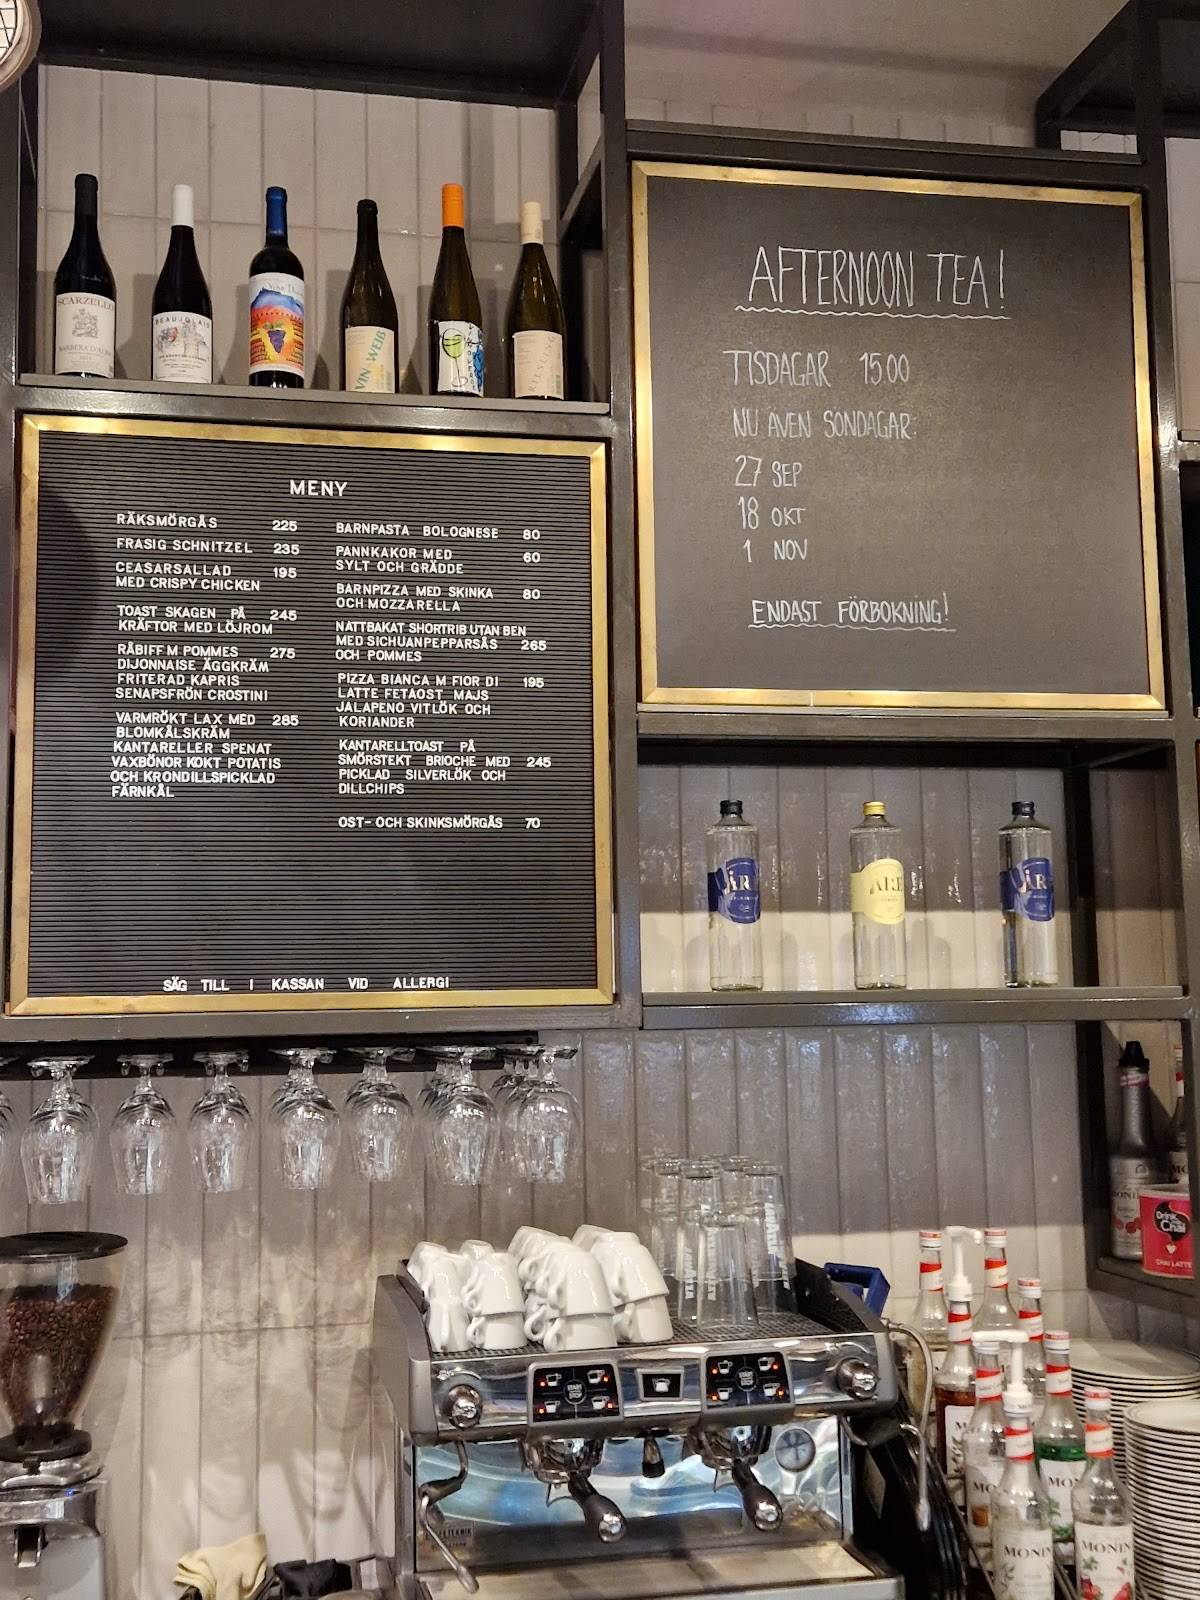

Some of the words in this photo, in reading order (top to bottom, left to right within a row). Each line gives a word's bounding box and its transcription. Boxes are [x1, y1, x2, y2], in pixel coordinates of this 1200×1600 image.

[748, 246, 914, 308] AFTERNOON
[155, 315, 210, 329] BEAUJOLAIS
[722, 350, 831, 387] TISDAGAR
[354, 367, 371, 390] VIN
[733, 408, 758, 437] NU
[735, 455, 762, 487] 27
[772, 461, 802, 487] SEP
[291, 480, 347, 496] MENY
[738, 496, 759, 529] 18
[772, 507, 806, 527] OKT
[117, 511, 217, 528] RÄKSMÖRGÅS
[273, 520, 297, 531] 225
[337, 523, 409, 535] BARNPASTA
[424, 526, 498, 538] BOLOGNESE
[523, 530, 540, 539] 80
[117, 538, 166, 549] FRASIG
[173, 540, 252, 552] SCHNITZEL
[274, 544, 299, 554] 235
[743, 539, 752, 562] 1
[773, 539, 808, 561] NOV
[337, 546, 416, 558] PANNKAKOR
[424, 549, 451, 559] MED
[523, 552, 540, 562] 60
[116, 562, 231, 575] CEASARSALLAD
[274, 568, 296, 578] 195
[336, 560, 369, 571] SYLT
[377, 561, 403, 572] OCH
[411, 560, 463, 573] GRÄDDE
[116, 576, 144, 587] MED
[150, 578, 197, 588] CRISPY
[202, 579, 259, 590] CHICKEN
[337, 583, 408, 595] BARNPIZZA
[416, 586, 440, 596] MED
[449, 587, 493, 598] SKINKA
[523, 589, 540, 599] 80
[337, 598, 363, 608] OCH
[369, 599, 460, 611] MOZZARELLA
[752, 600, 822, 624] ENDAST
[117, 605, 157, 617] TOAST
[166, 607, 215, 618] SKAGEN
[231, 606, 245, 619] PÅ
[270, 610, 296, 620] 245
[119, 617, 177, 631] KRÄFTOR
[185, 622, 212, 632] MED
[218, 620, 272, 634] LÖJROM
[336, 621, 404, 633] NATTBAKAT
[409, 623, 466, 634] SHORTRIB
[470, 625, 499, 635] UTAN
[503, 626, 526, 636] BEN
[118, 642, 164, 655] RÅBIFF
[167, 645, 177, 655] M
[184, 646, 238, 657] POMMES
[270, 648, 295, 658] 275
[337, 635, 363, 645] MED
[367, 636, 497, 649] SICHUANPEPPARSÅS
[521, 640, 546, 650] 265
[336, 650, 359, 659] OCH
[368, 650, 421, 661] POMMES
[118, 659, 196, 670] DIJONNAISE
[203, 658, 268, 672] ÄGGKRÄM
[118, 673, 184, 685] FRITERAD
[191, 675, 239, 685] KAPRIS
[338, 673, 374, 684] PIZZA
[382, 674, 429, 685] BIANCA
[436, 676, 446, 685] M
[453, 676, 479, 686] FIOR
[486, 677, 498, 686] DI
[524, 677, 544, 687] 195
[116, 687, 202, 699] SENAPSFRÖN
[208, 690, 267, 700] CROSTINI
[339, 688, 378, 698] LATTE
[385, 688, 443, 699] FETAOST
[454, 690, 488, 700] MAJS
[336, 702, 404, 713] JALAPENO
[411, 701, 457, 714] VITLÖK
[465, 704, 490, 714] OCH
[116, 710, 187, 724] VARMRÖKT
[194, 714, 222, 724] LAX
[229, 714, 255, 725] MED
[273, 715, 298, 725] 285
[340, 716, 414, 727] KORIANDER
[117, 725, 229, 738] BLOMKÅLSKRÄM
[114, 741, 213, 753] KANTARELLER
[222, 743, 271, 754] SPENAT
[340, 740, 443, 751] KANTARELLTOAST
[461, 739, 475, 752] PÅ
[112, 754, 181, 767] VAXBÖNOR
[187, 757, 221, 768] KOKT
[228, 758, 281, 769] POTATIS
[338, 752, 411, 765] SMÖRSTEKT
[426, 756, 476, 766] BRIOCHE
[486, 757, 510, 766] MED
[527, 757, 551, 767] 245
[110, 770, 138, 782] OCH
[144, 771, 275, 783] KRONDILLSPICKLAD
[339, 769, 390, 779] PICKLAD
[406, 767, 471, 780] SILVERLÖK
[482, 770, 505, 780] OCH
[112, 783, 174, 797] FÄRNKÅL
[339, 783, 404, 794] DILLCHIPS
[376, 817, 401, 827] OCH
[407, 815, 502, 828] SKINKSMÖRGÅS
[526, 818, 540, 828] 70
[163, 976, 187, 991] SÄG
[201, 980, 229, 991] TILL
[250, 979, 253, 990] I
[272, 978, 323, 990] KASSAN
[348, 978, 368, 989] VID
[393, 977, 448, 988] ALLERGI
